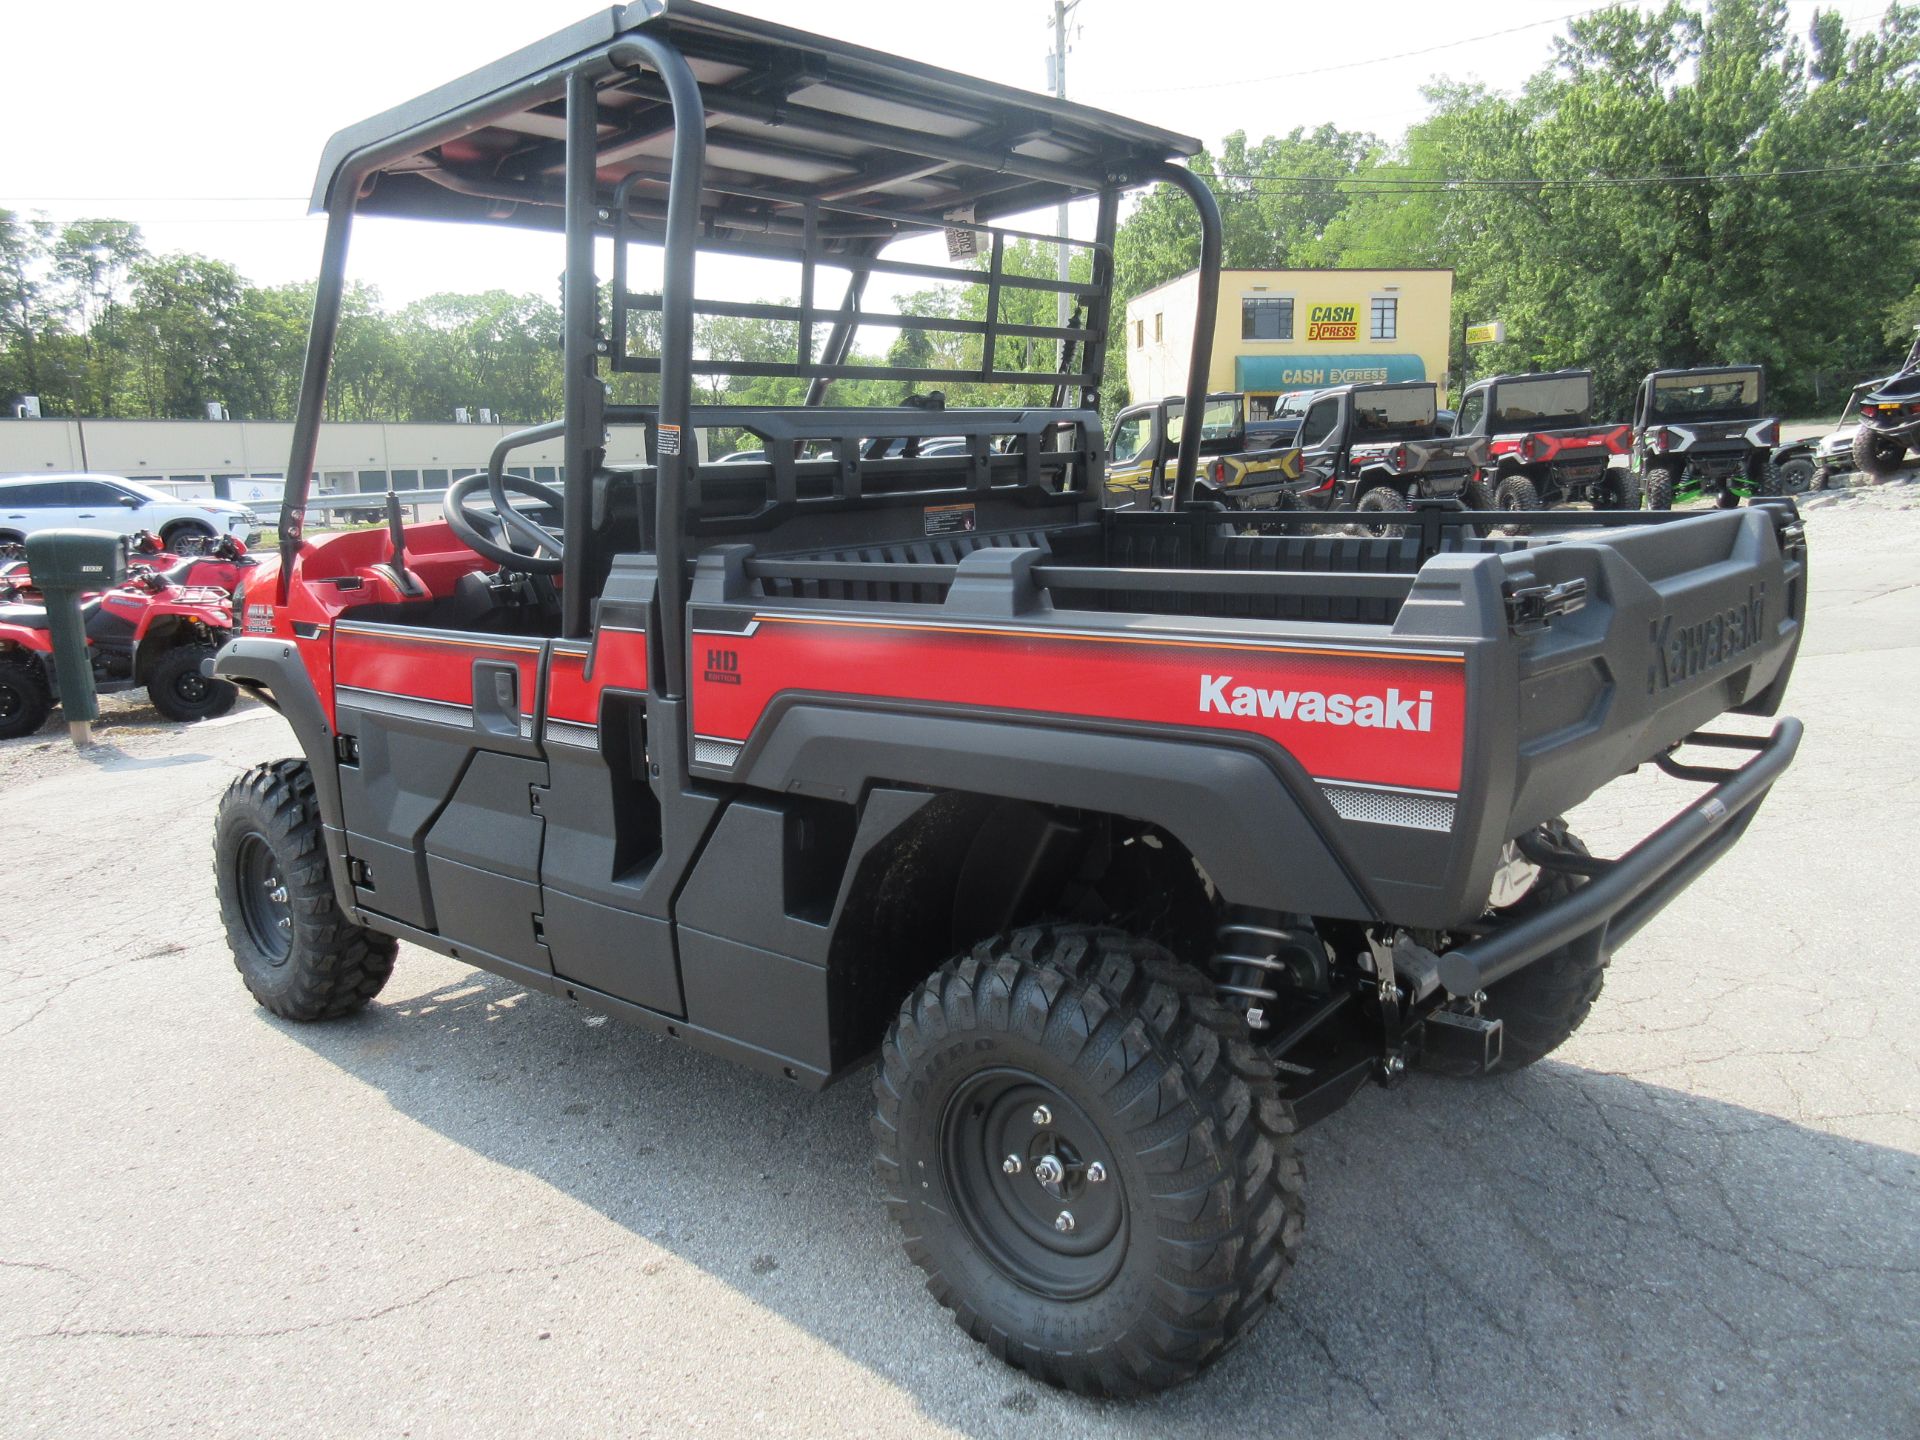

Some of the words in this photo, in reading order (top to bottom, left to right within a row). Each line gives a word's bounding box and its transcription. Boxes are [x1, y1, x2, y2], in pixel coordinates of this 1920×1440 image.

[1311, 306, 1355, 322] CASH
[1308, 322, 1357, 341] EXPRESS
[1282, 369, 1325, 384] CASH
[1329, 368, 1388, 384] EXPRESS
[1646, 580, 1765, 695] Kawasaki
[707, 649, 738, 672] HD
[1199, 674, 1433, 732] Kawasaki
